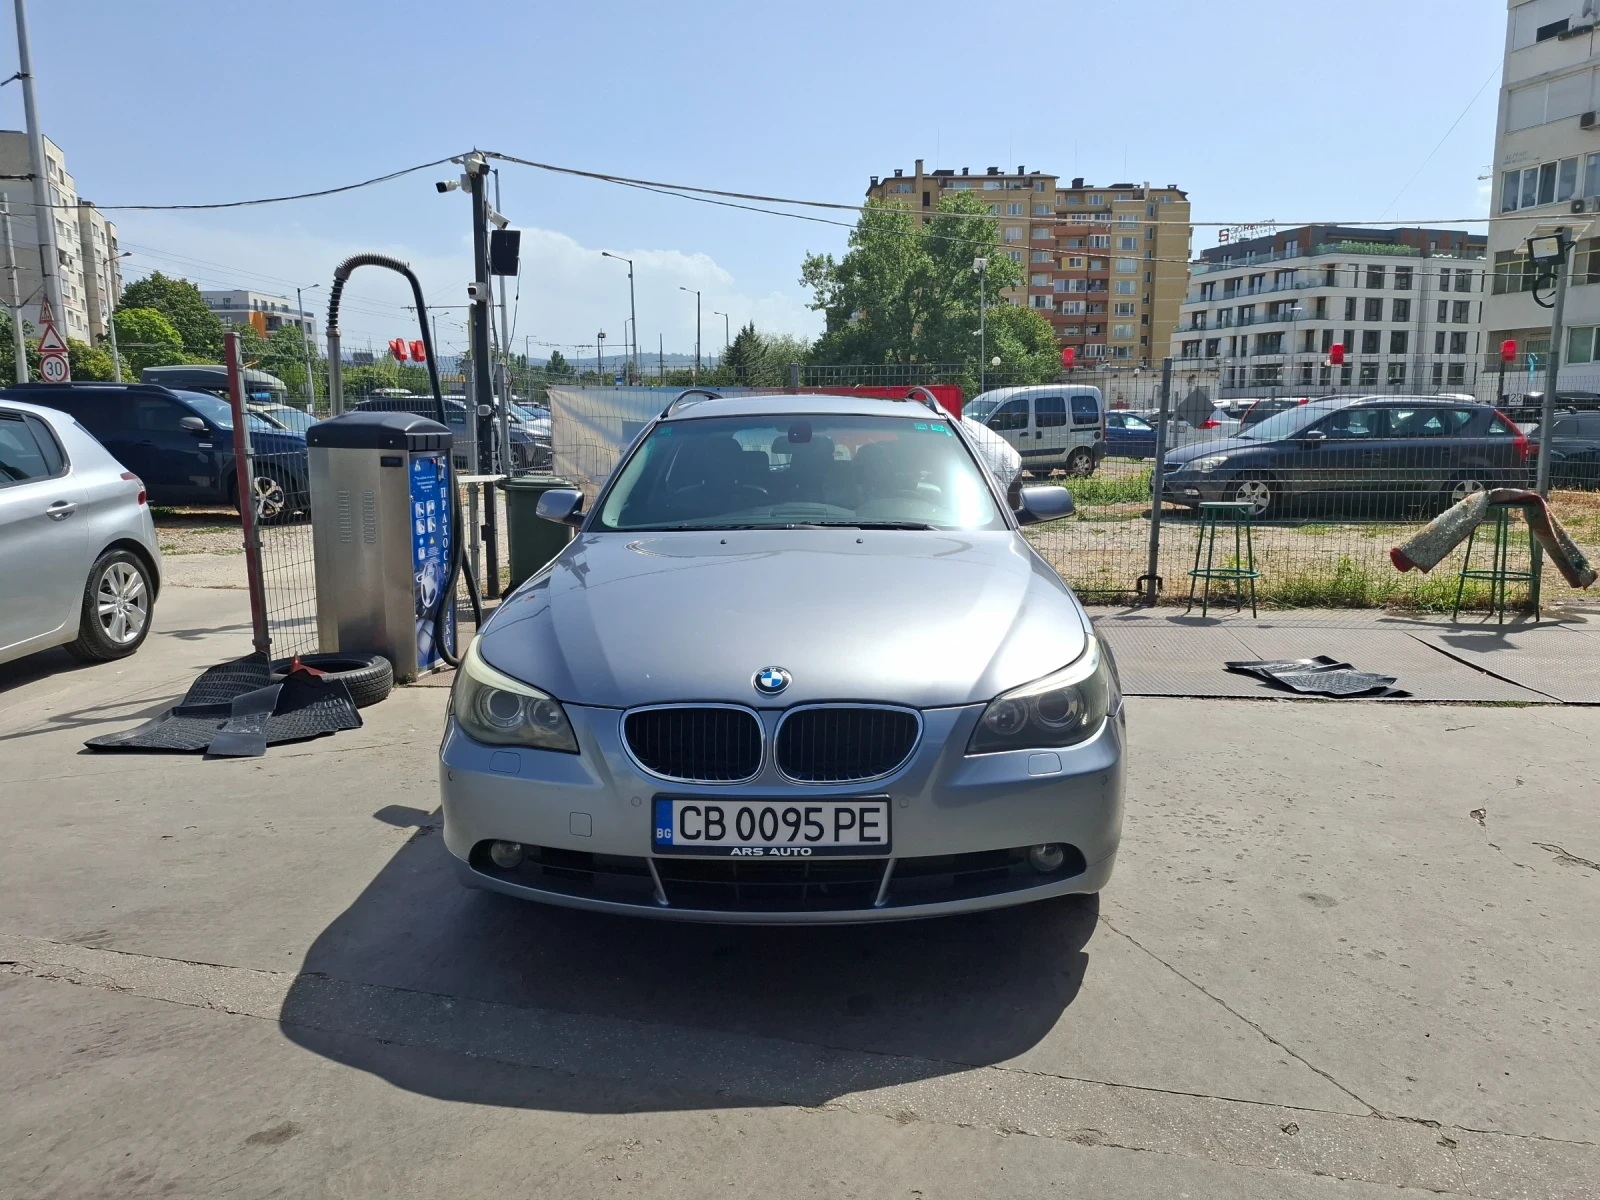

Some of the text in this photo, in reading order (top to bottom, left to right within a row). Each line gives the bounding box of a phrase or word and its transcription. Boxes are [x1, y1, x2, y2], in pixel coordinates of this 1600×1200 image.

[46, 361, 62, 376] 30
[1510, 393, 1523, 403] 23
[679, 805, 881, 842] CB 0095 PE
[656, 828, 672, 839] BG
[730, 847, 812, 856] ARS AUTO
